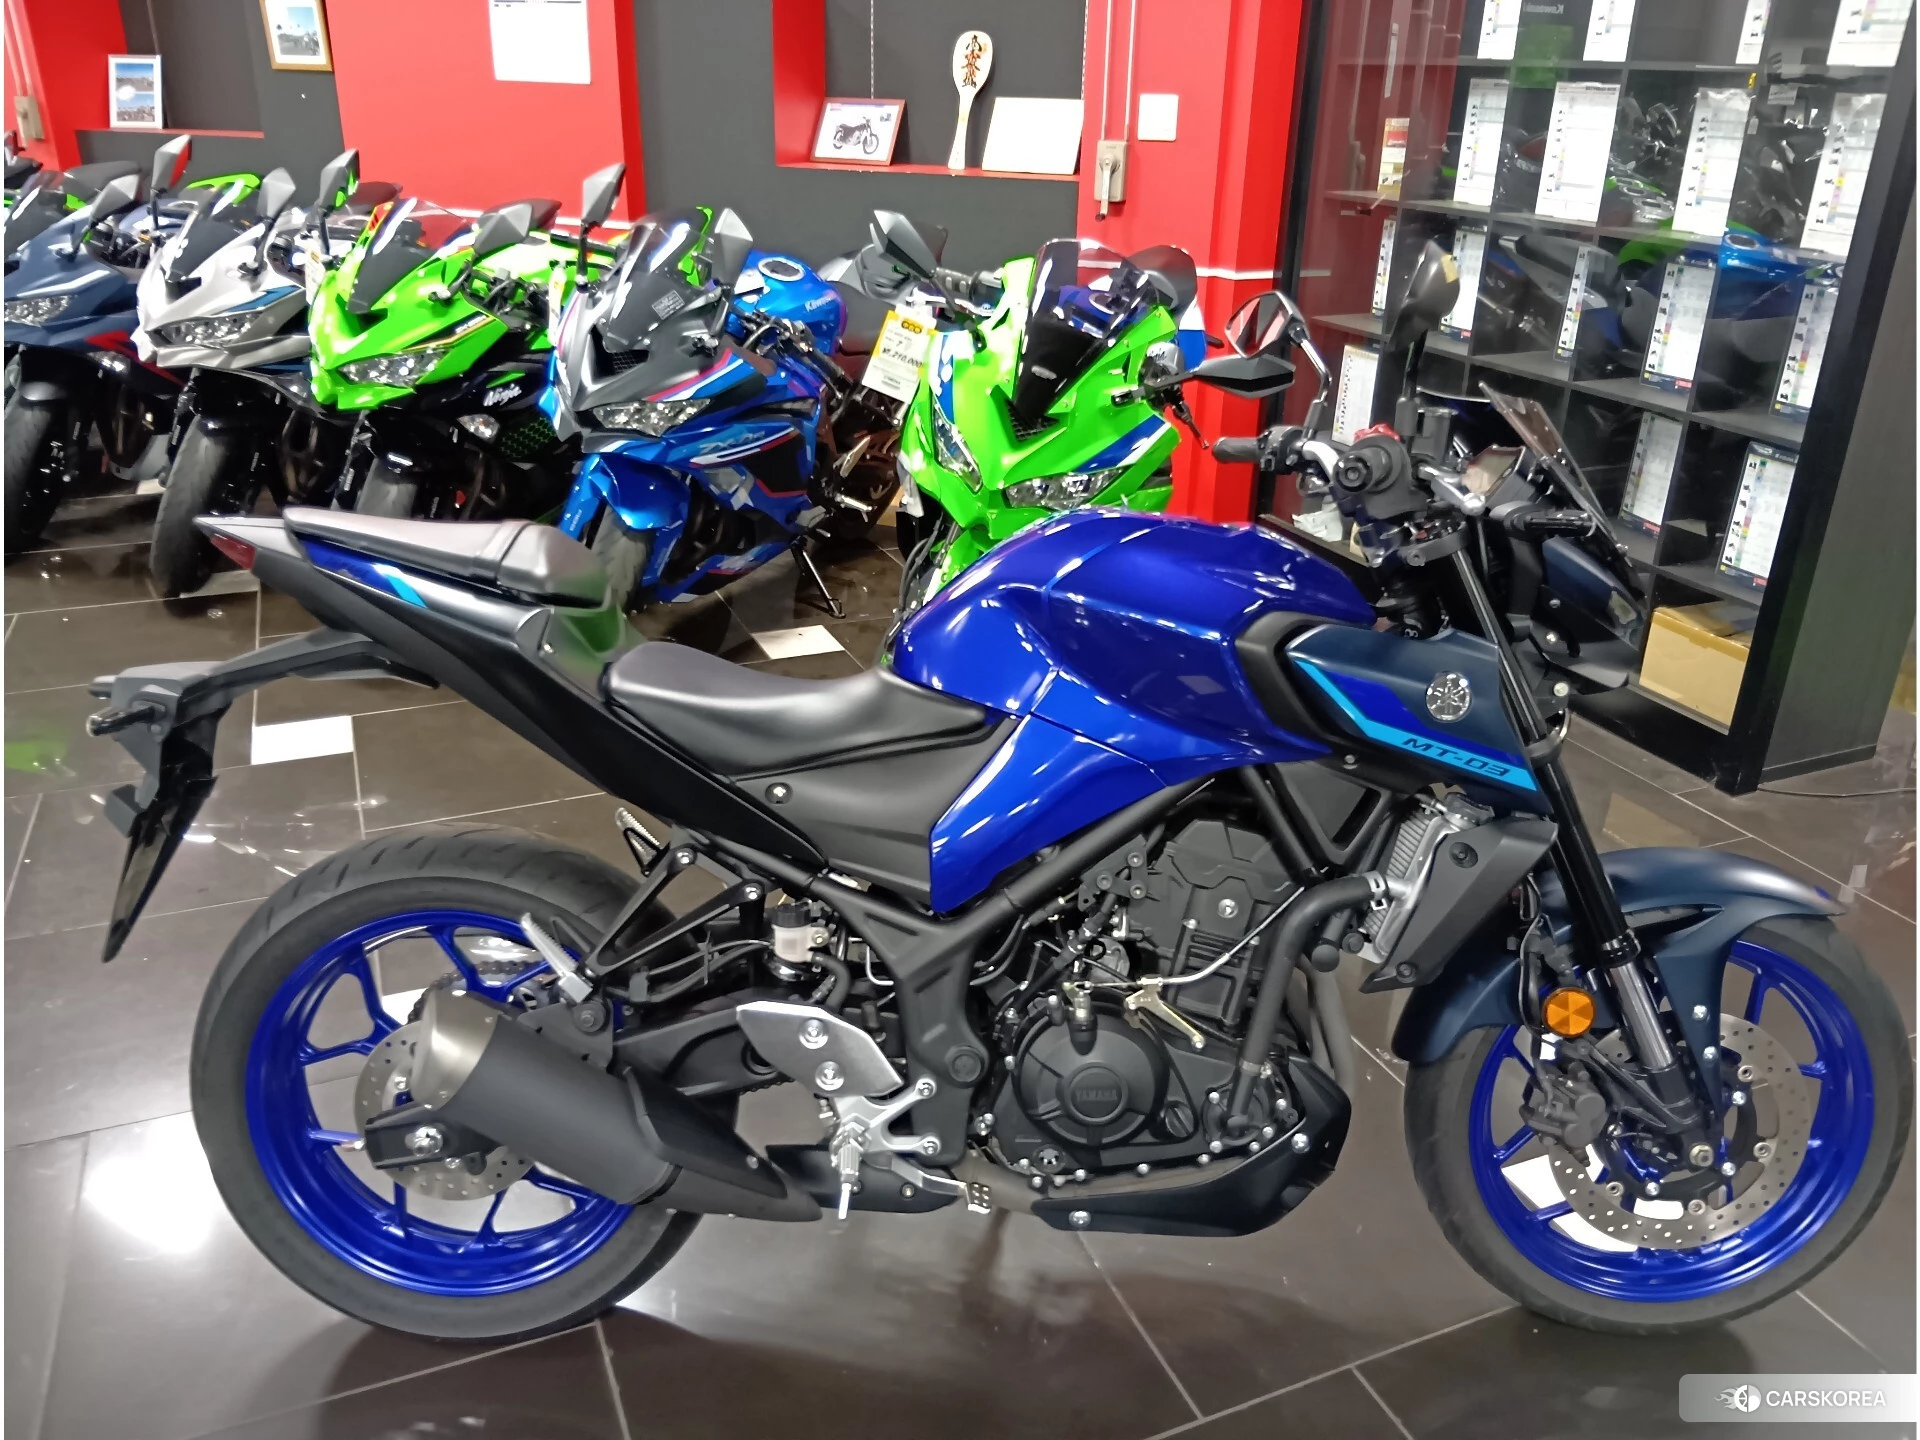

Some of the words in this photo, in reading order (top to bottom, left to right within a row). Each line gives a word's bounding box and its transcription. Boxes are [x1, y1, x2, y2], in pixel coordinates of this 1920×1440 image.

[483, 383, 522, 407] Ninja
[1402, 737, 1511, 777] MT-03
[1075, 1088, 1118, 1101] YAMAHA
